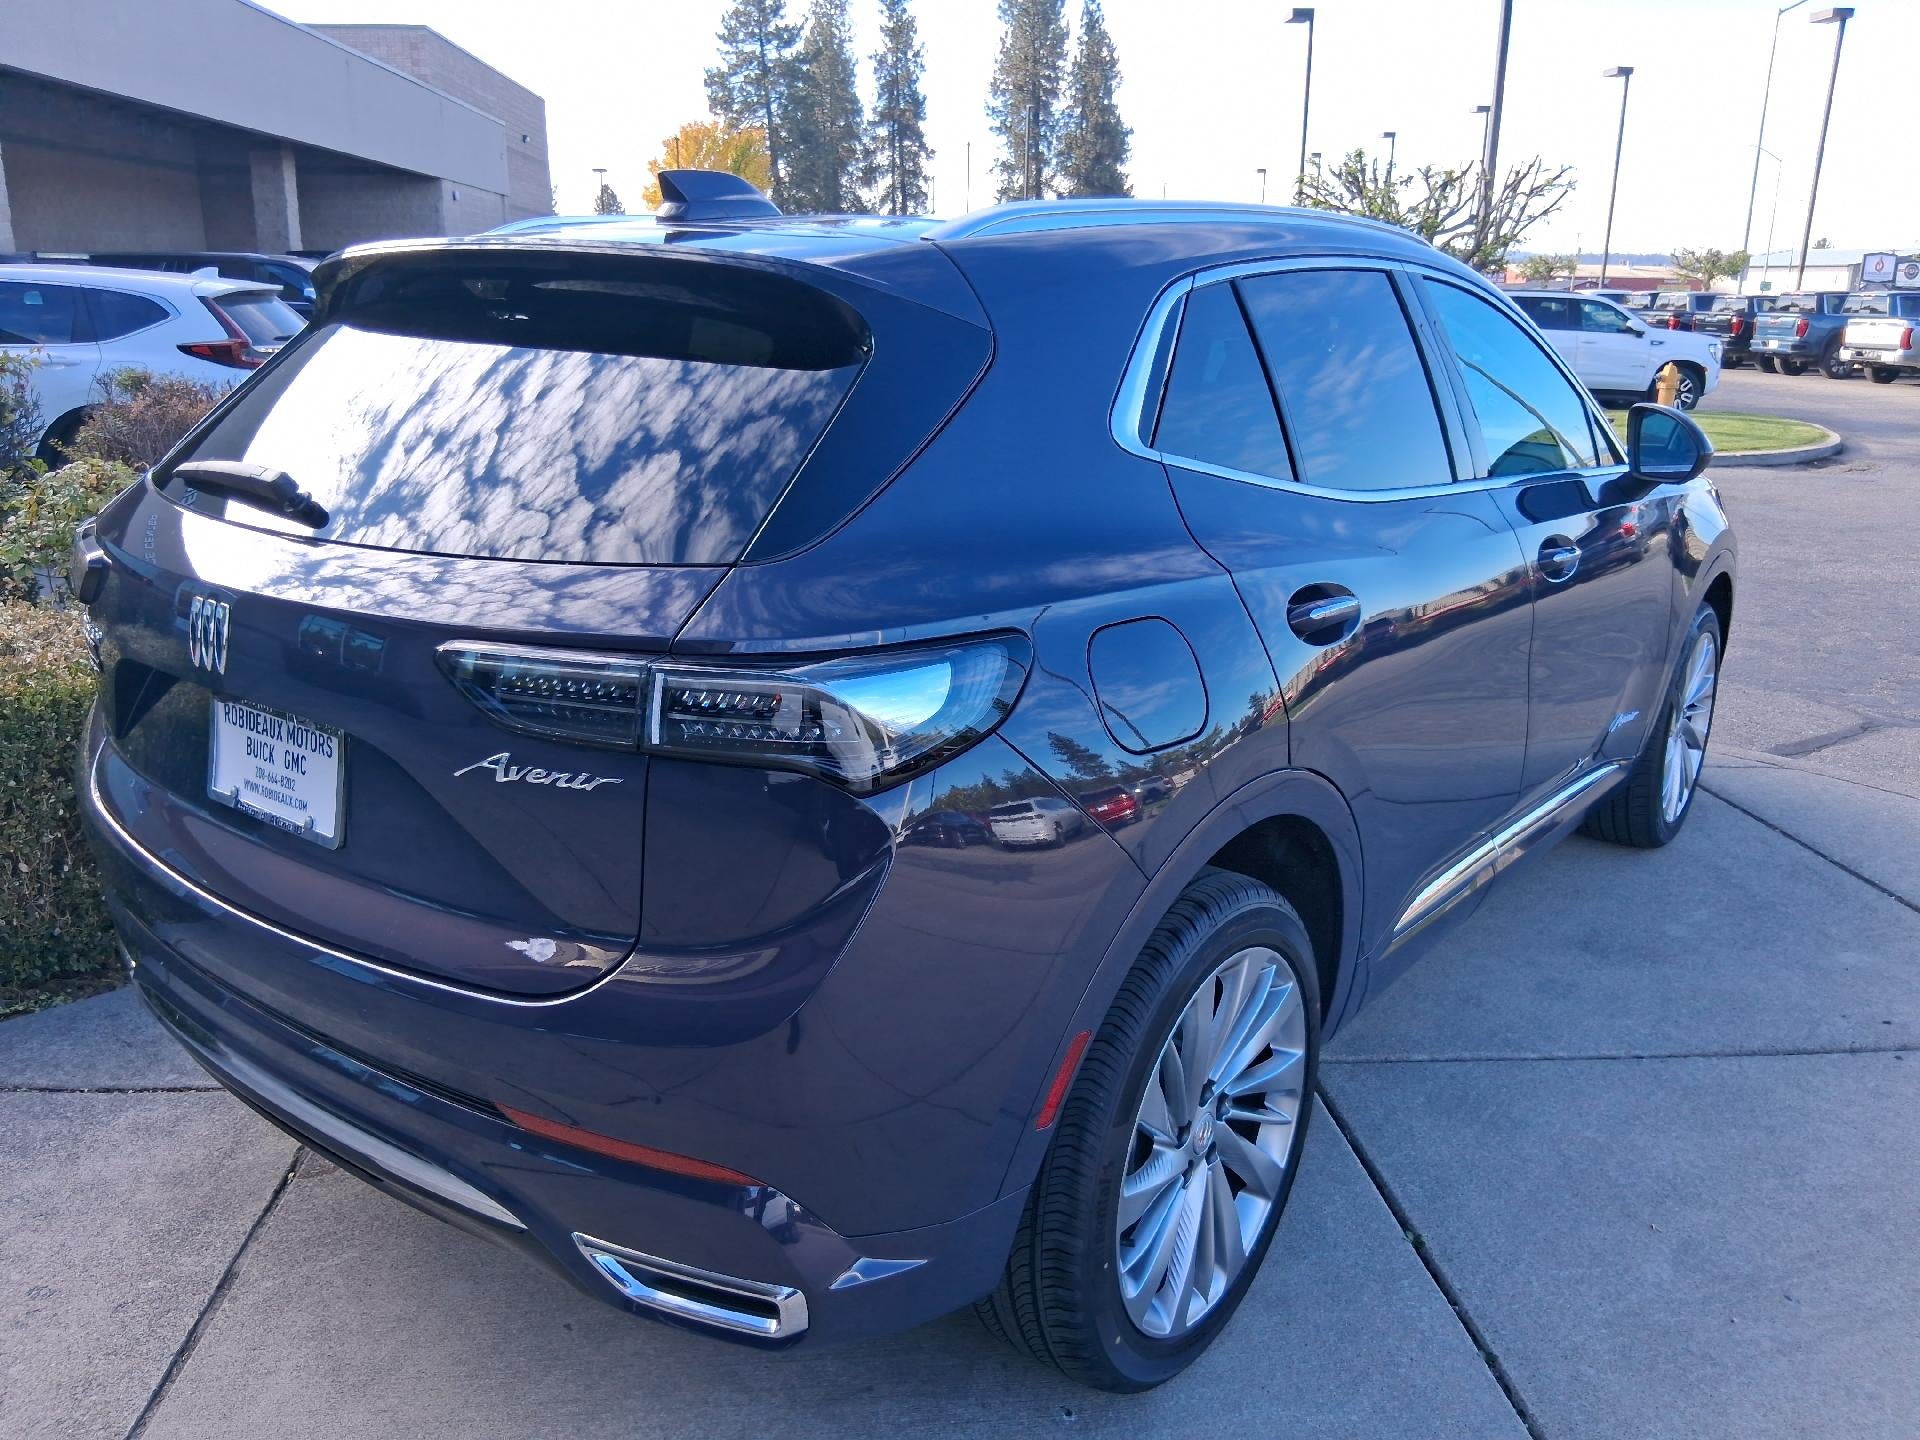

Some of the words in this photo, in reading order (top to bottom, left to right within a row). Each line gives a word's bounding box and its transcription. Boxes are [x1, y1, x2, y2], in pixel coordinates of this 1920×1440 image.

[225, 704, 283, 742] ROBIDEAUX
[287, 724, 333, 758] MOTORS
[247, 736, 275, 765] BUICK
[285, 750, 307, 775] GMC
[453, 752, 625, 791] Avenir
[244, 779, 308, 812] WWW.ROBIDEAUX.COM
[255, 766, 296, 792] 208-664-8202
